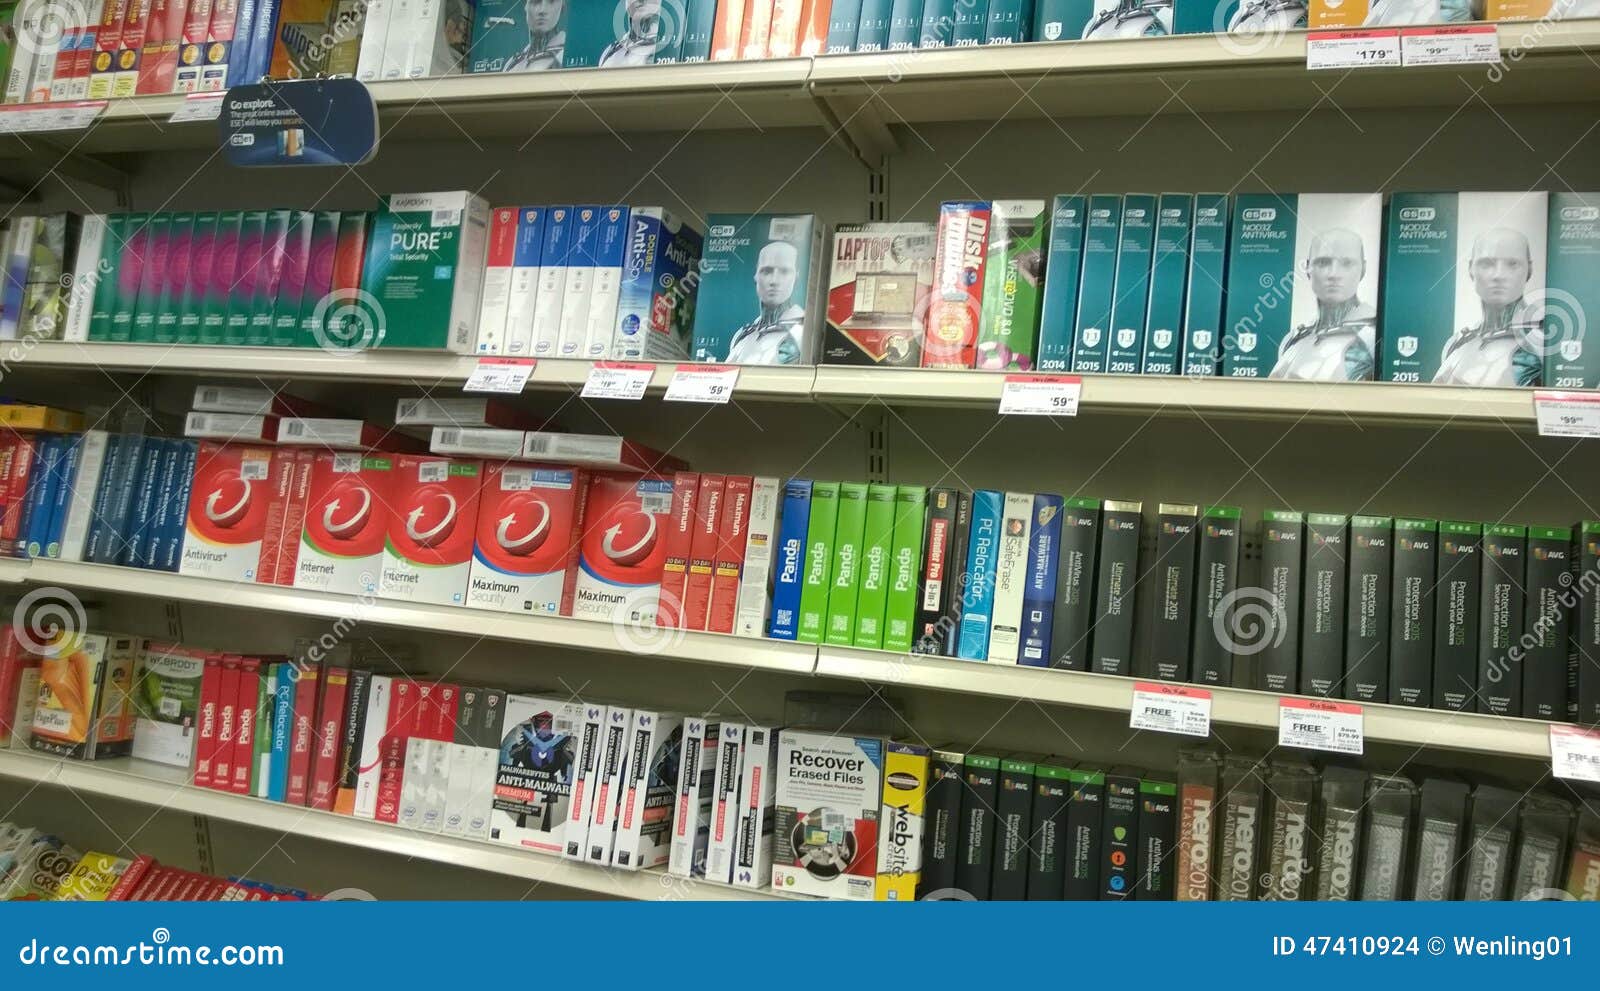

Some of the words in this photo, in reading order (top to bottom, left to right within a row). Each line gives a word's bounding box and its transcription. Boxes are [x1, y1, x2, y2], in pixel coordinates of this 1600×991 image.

[829, 45, 850, 54] 2014
[859, 42, 881, 52] 2014
[891, 42, 913, 50] 2014
[955, 39, 979, 47] 2014
[990, 37, 1012, 45] 2014
[684, 55, 704, 65] 2014
[230, 100, 242, 110] Go
[243, 99, 276, 110] explore.
[390, 232, 440, 250] PURE
[962, 216, 987, 272] Disk
[1240, 231, 1288, 240] ANTIVIRUS
[1398, 231, 1448, 240] ANTIVIRUS
[837, 237, 891, 261] LAPTOP
[1000, 319, 1012, 335] 8.0
[1041, 360, 1065, 370] 2014
[1076, 360, 1100, 371] 2015
[1111, 362, 1136, 372] 2015
[1147, 363, 1172, 373] 2015
[1232, 367, 1258, 377] 2015
[1392, 372, 1420, 383] 2015
[1555, 377, 1584, 387] 2015
[19, 444, 31, 478] nero
[280, 462, 291, 497] Premium
[299, 463, 310, 498] Premium
[680, 490, 692, 532] Maximum
[706, 491, 719, 534] Maximum
[732, 493, 745, 536] Maximum
[980, 517, 993, 535] PC
[1120, 522, 1135, 530] AVG
[1219, 529, 1234, 537] AVG
[931, 522, 945, 563] Defender
[1325, 536, 1341, 544] AVG
[1370, 539, 1385, 547] AVG
[1413, 542, 1430, 550] AVG
[1458, 545, 1474, 553] AVG
[781, 539, 797, 583] Panda
[1502, 548, 1519, 556] AVG
[1548, 551, 1564, 559] AVG
[301, 561, 335, 574] Internet
[808, 542, 825, 585] Panda
[837, 544, 853, 587] Panda
[865, 546, 882, 590] Panda
[895, 548, 912, 591] Panda
[972, 537, 991, 601] Relocator
[1001, 536, 1018, 592] SafeErase
[1034, 534, 1048, 590] ANTI-MALWARE
[1072, 551, 1083, 586] AntiVirus
[384, 570, 419, 583] Internet
[929, 564, 942, 579] Pro
[1214, 562, 1226, 599] AntiVirus
[472, 578, 519, 594] Maximum
[1278, 567, 1289, 608] Protection
[1323, 570, 1333, 613] Protection
[578, 589, 627, 603] Maximum
[1367, 574, 1378, 617] Protection
[1411, 577, 1421, 620] Protection
[1456, 581, 1466, 625] Protection
[1111, 596, 1121, 615] 2015
[1168, 600, 1178, 620] 2015
[1500, 584, 1511, 628] Protection
[1411, 621, 1420, 641] 2015
[348, 676, 365, 743] PhantomPDF
[1145, 706, 1172, 717] FREE
[202, 702, 214, 738] Panda
[220, 706, 233, 741] Panda
[239, 708, 250, 744] Panda
[274, 701, 289, 752] Relocator
[1293, 723, 1322, 733] FREE
[296, 716, 309, 752] Panda
[321, 721, 336, 758] Panda
[790, 749, 865, 772] Recover
[501, 765, 550, 778] MALWAREBYTES
[789, 767, 831, 781] Erased
[834, 771, 864, 785] Files
[498, 774, 571, 794] ANTI-MALWAR
[978, 777, 992, 785] AVG
[1015, 783, 1028, 791] AVG
[497, 787, 532, 800] PREMIUM
[1049, 788, 1063, 796] AVG
[1084, 794, 1098, 802] AVG
[1120, 787, 1135, 796] AVG
[1155, 805, 1170, 813] AVG
[1223, 803, 1237, 858] PLATINUM
[1272, 811, 1285, 864] PLATINUM
[892, 803, 913, 878] website
[1081, 826, 1091, 861] AntiVirus
[1152, 837, 1162, 873] AntiVirus
